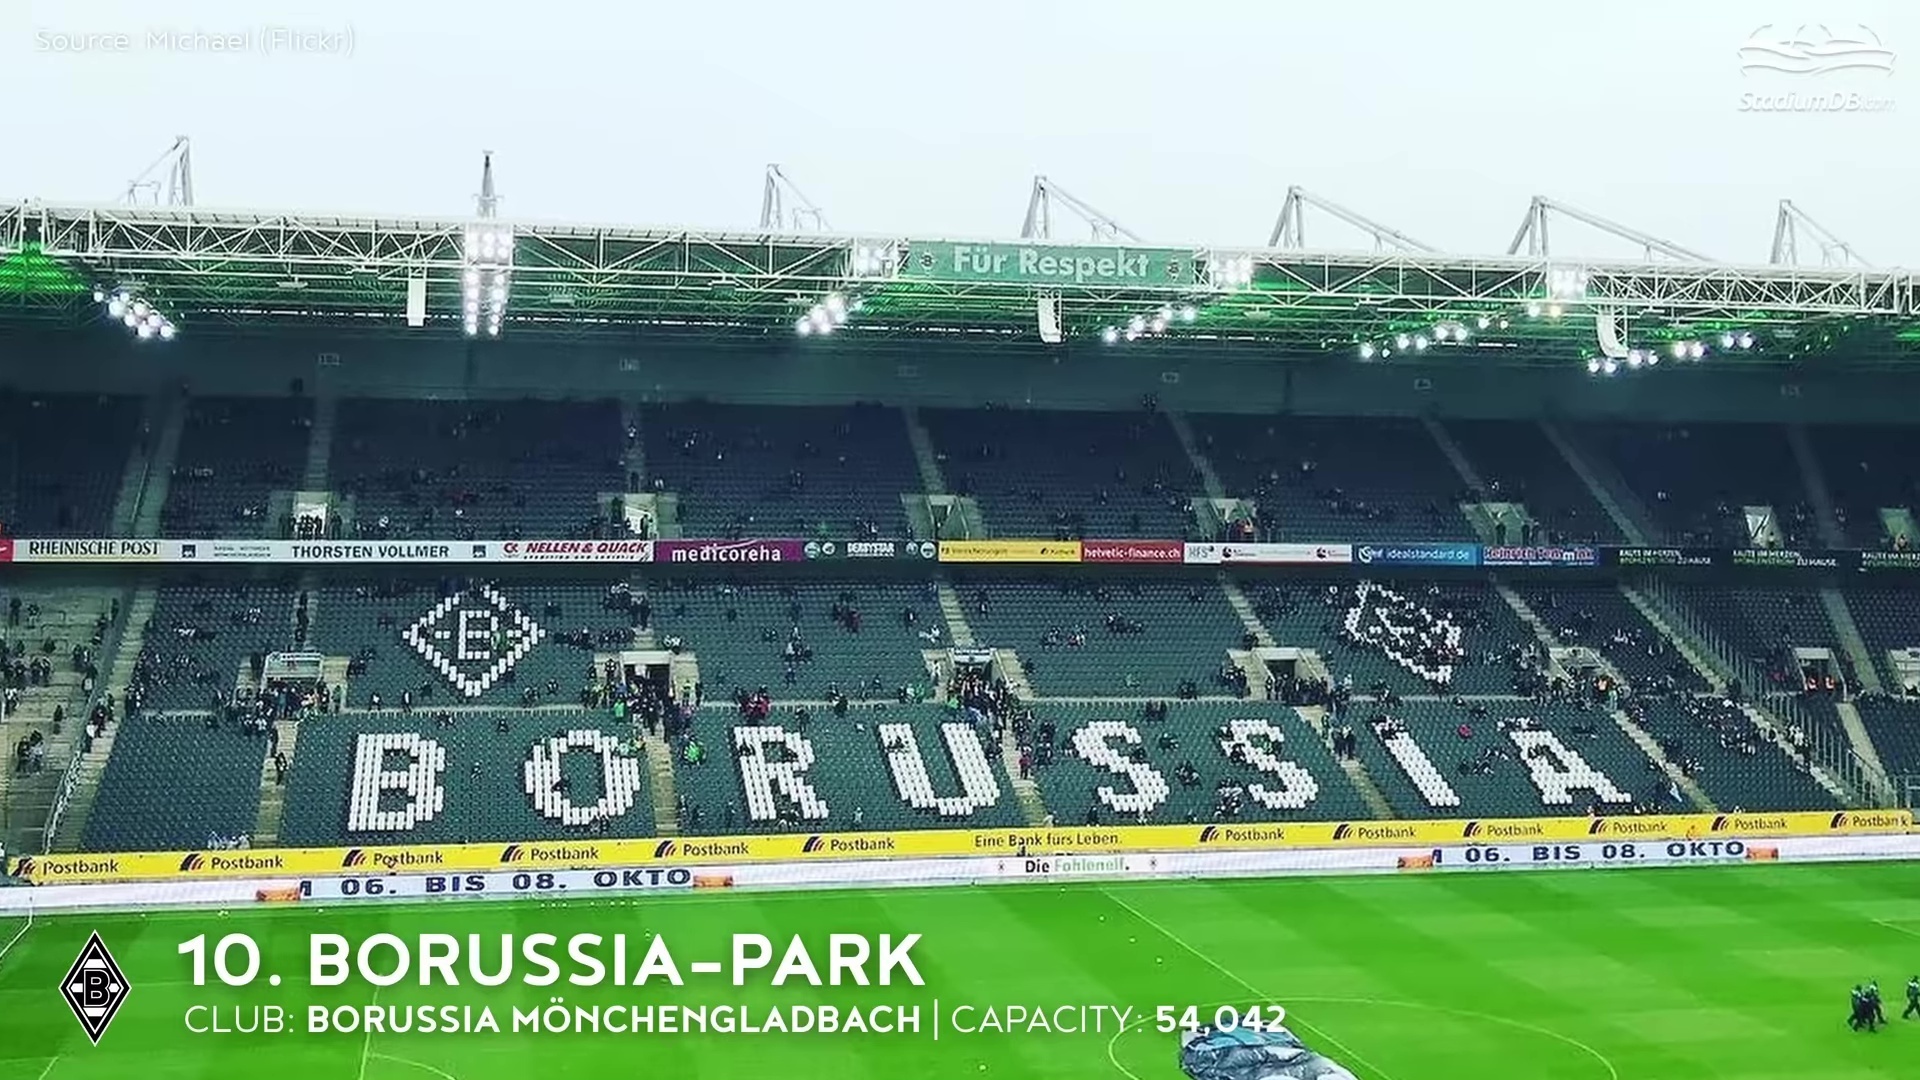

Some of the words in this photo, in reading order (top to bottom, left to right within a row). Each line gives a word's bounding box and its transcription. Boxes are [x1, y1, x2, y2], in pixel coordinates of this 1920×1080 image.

[954, 246, 1007, 275] Für
[1019, 248, 1149, 283] Respekt
[29, 540, 116, 556] RHEINISCHE
[121, 540, 160, 556] POST
[291, 545, 373, 558] THORSTEN
[378, 545, 449, 558] VOLLMER
[526, 542, 579, 554] NELLEN
[582, 542, 593, 554] &
[597, 542, 648, 554] QUACK
[672, 545, 781, 562] medicoreha
[1613, 821, 1667, 834] Postbank
[1735, 817, 1788, 831] Postbank
[1852, 814, 1908, 827] Postbank
[1225, 827, 1284, 842] Postbank
[1358, 826, 1416, 839] Postbank
[1487, 823, 1544, 837] Postbank
[830, 837, 895, 852] Postbank
[975, 834, 1004, 848] Eine
[1009, 833, 1042, 847] Bank
[531, 846, 599, 861] Postbank
[683, 842, 749, 857] Postbank
[1465, 846, 1510, 863] 06.
[1532, 845, 1581, 861] BIS
[1602, 843, 1644, 859] 08.
[1667, 840, 1745, 856] OKTO
[211, 855, 284, 870] Postbank
[373, 851, 443, 867] Postbank
[1025, 859, 1050, 873] Die
[43, 860, 119, 876] Postbank
[341, 877, 397, 895] 06.
[425, 875, 486, 892] BIS
[512, 872, 567, 890] 08.
[593, 868, 691, 887] OKTO
